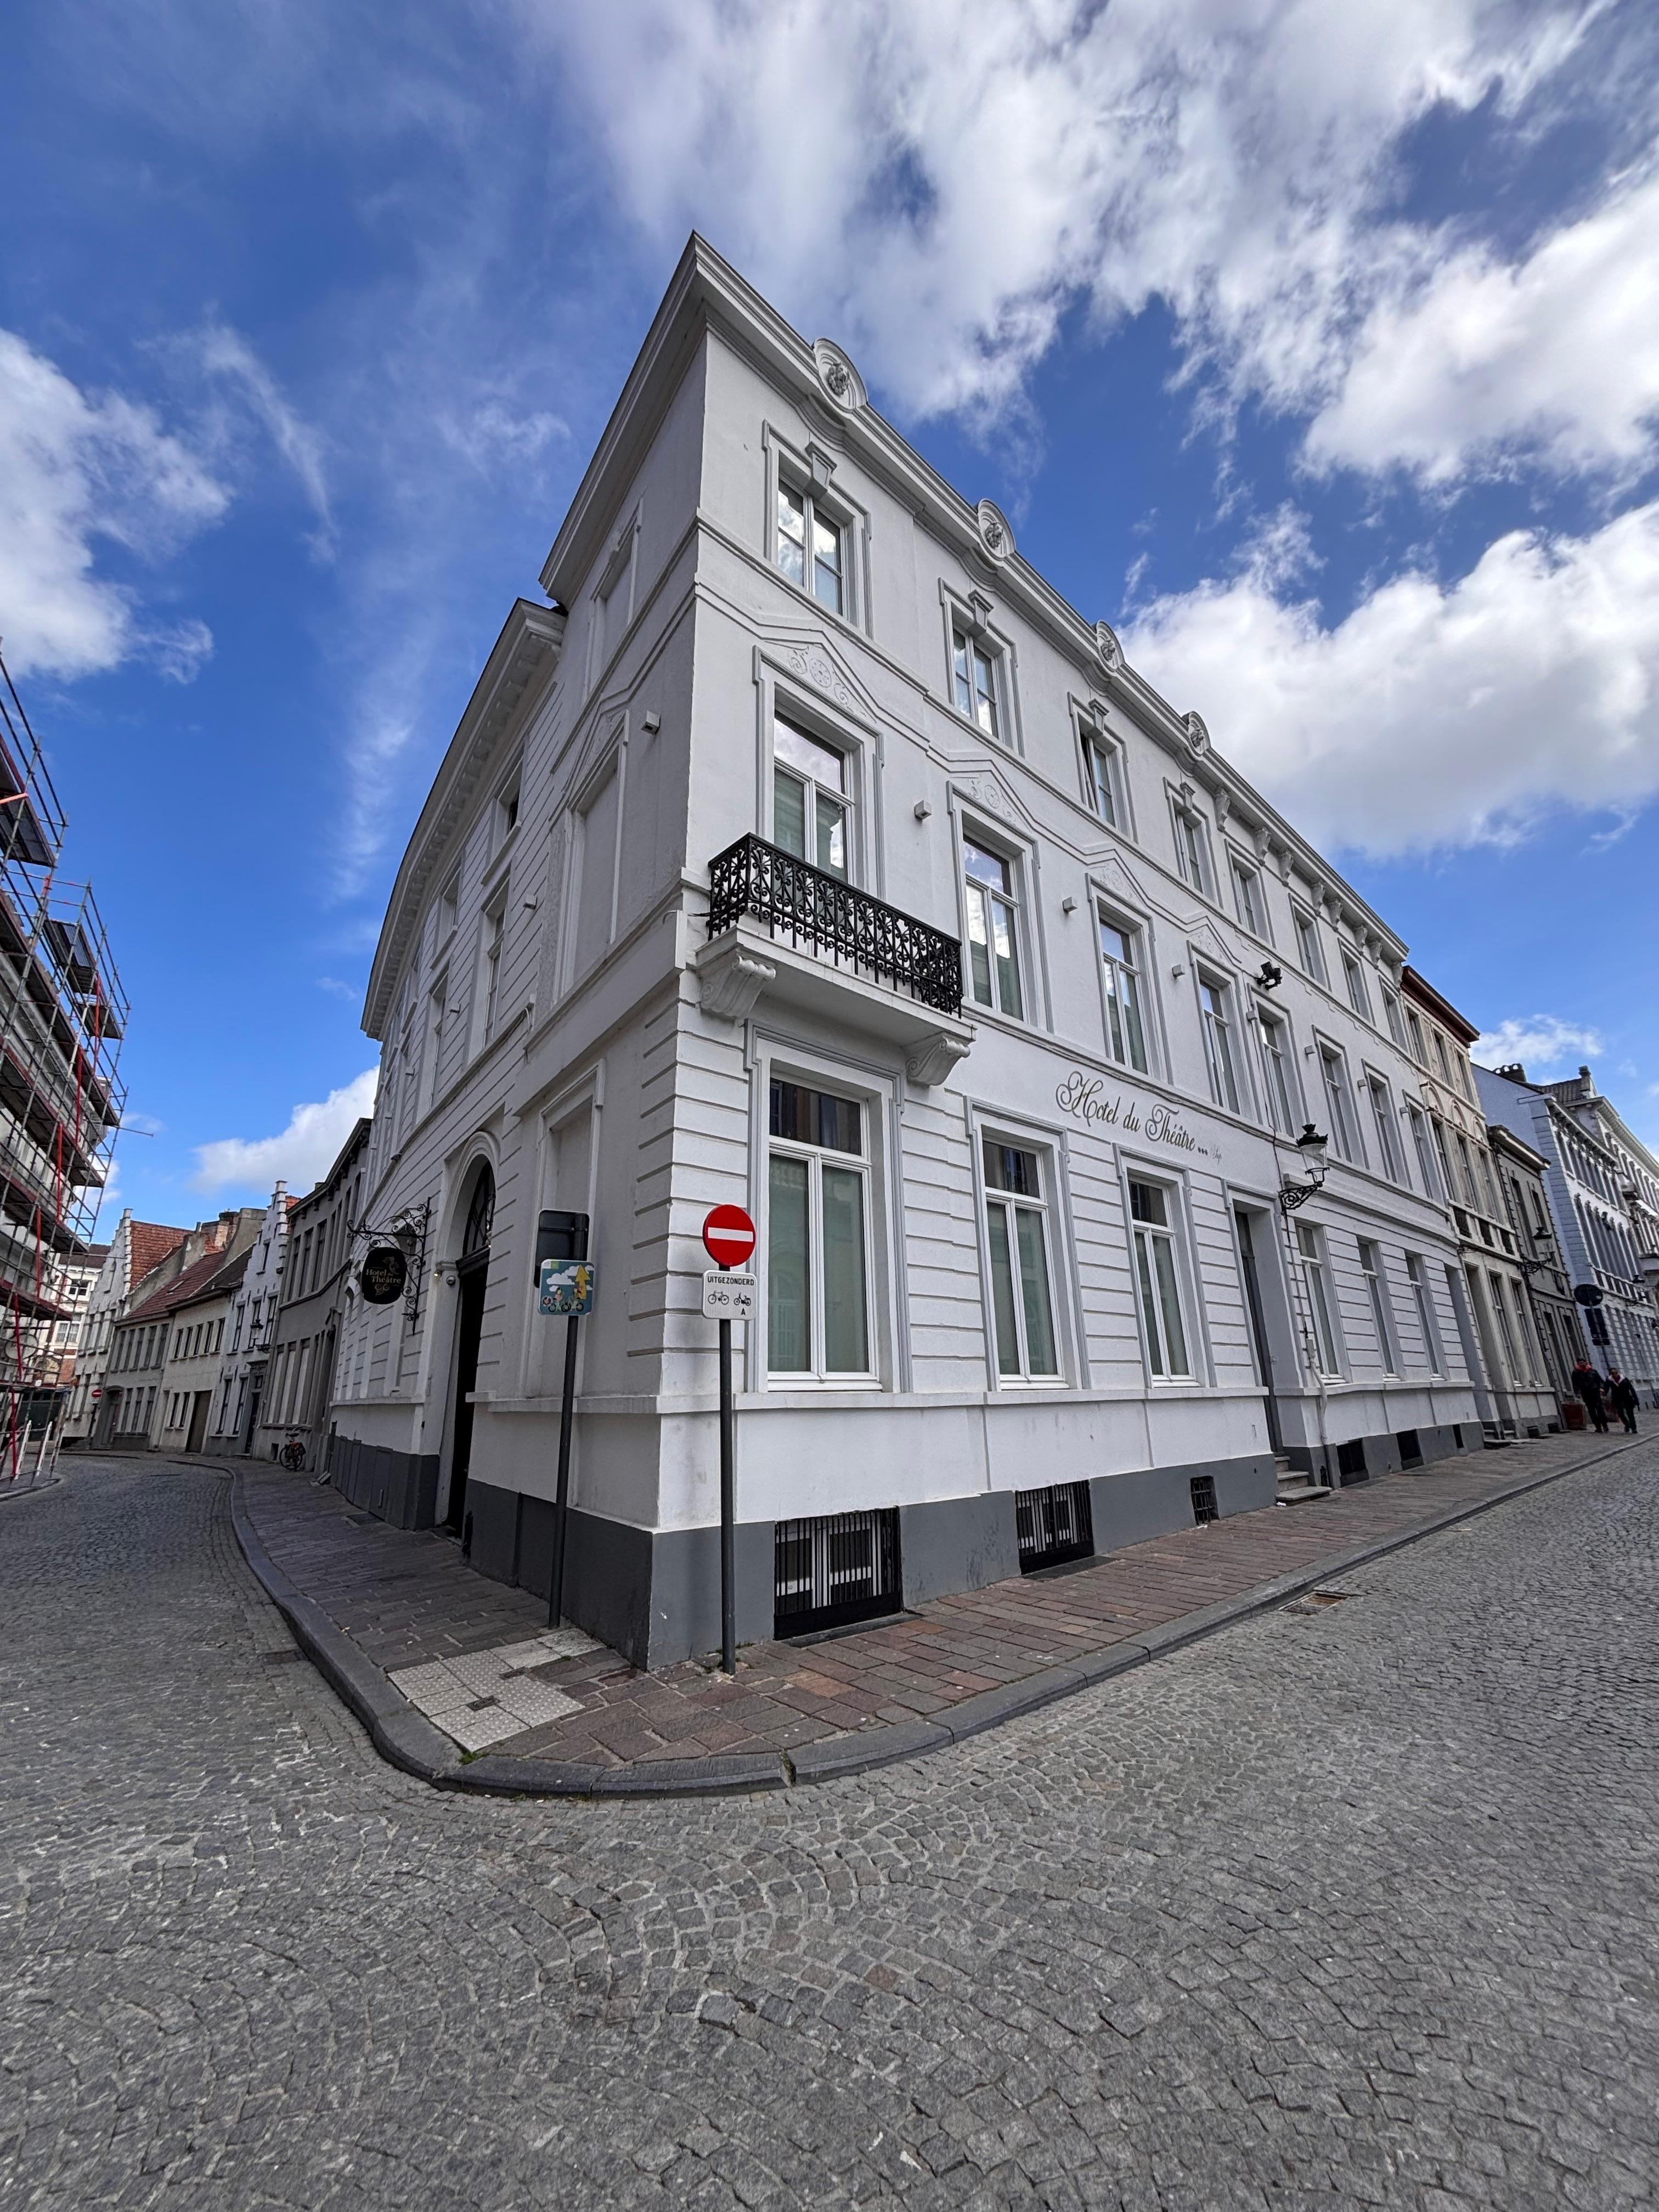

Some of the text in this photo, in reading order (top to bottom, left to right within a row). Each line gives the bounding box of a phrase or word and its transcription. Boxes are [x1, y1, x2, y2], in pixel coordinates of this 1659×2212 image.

[1056, 1071, 1121, 1127] Hotel
[1122, 1101, 1141, 1132] du
[1145, 1103, 1195, 1152] Théâtre
[371, 1276, 402, 1284] Théâtre
[707, 1276, 755, 1286] UITGEZONDERD
[741, 1307, 746, 1316] A
